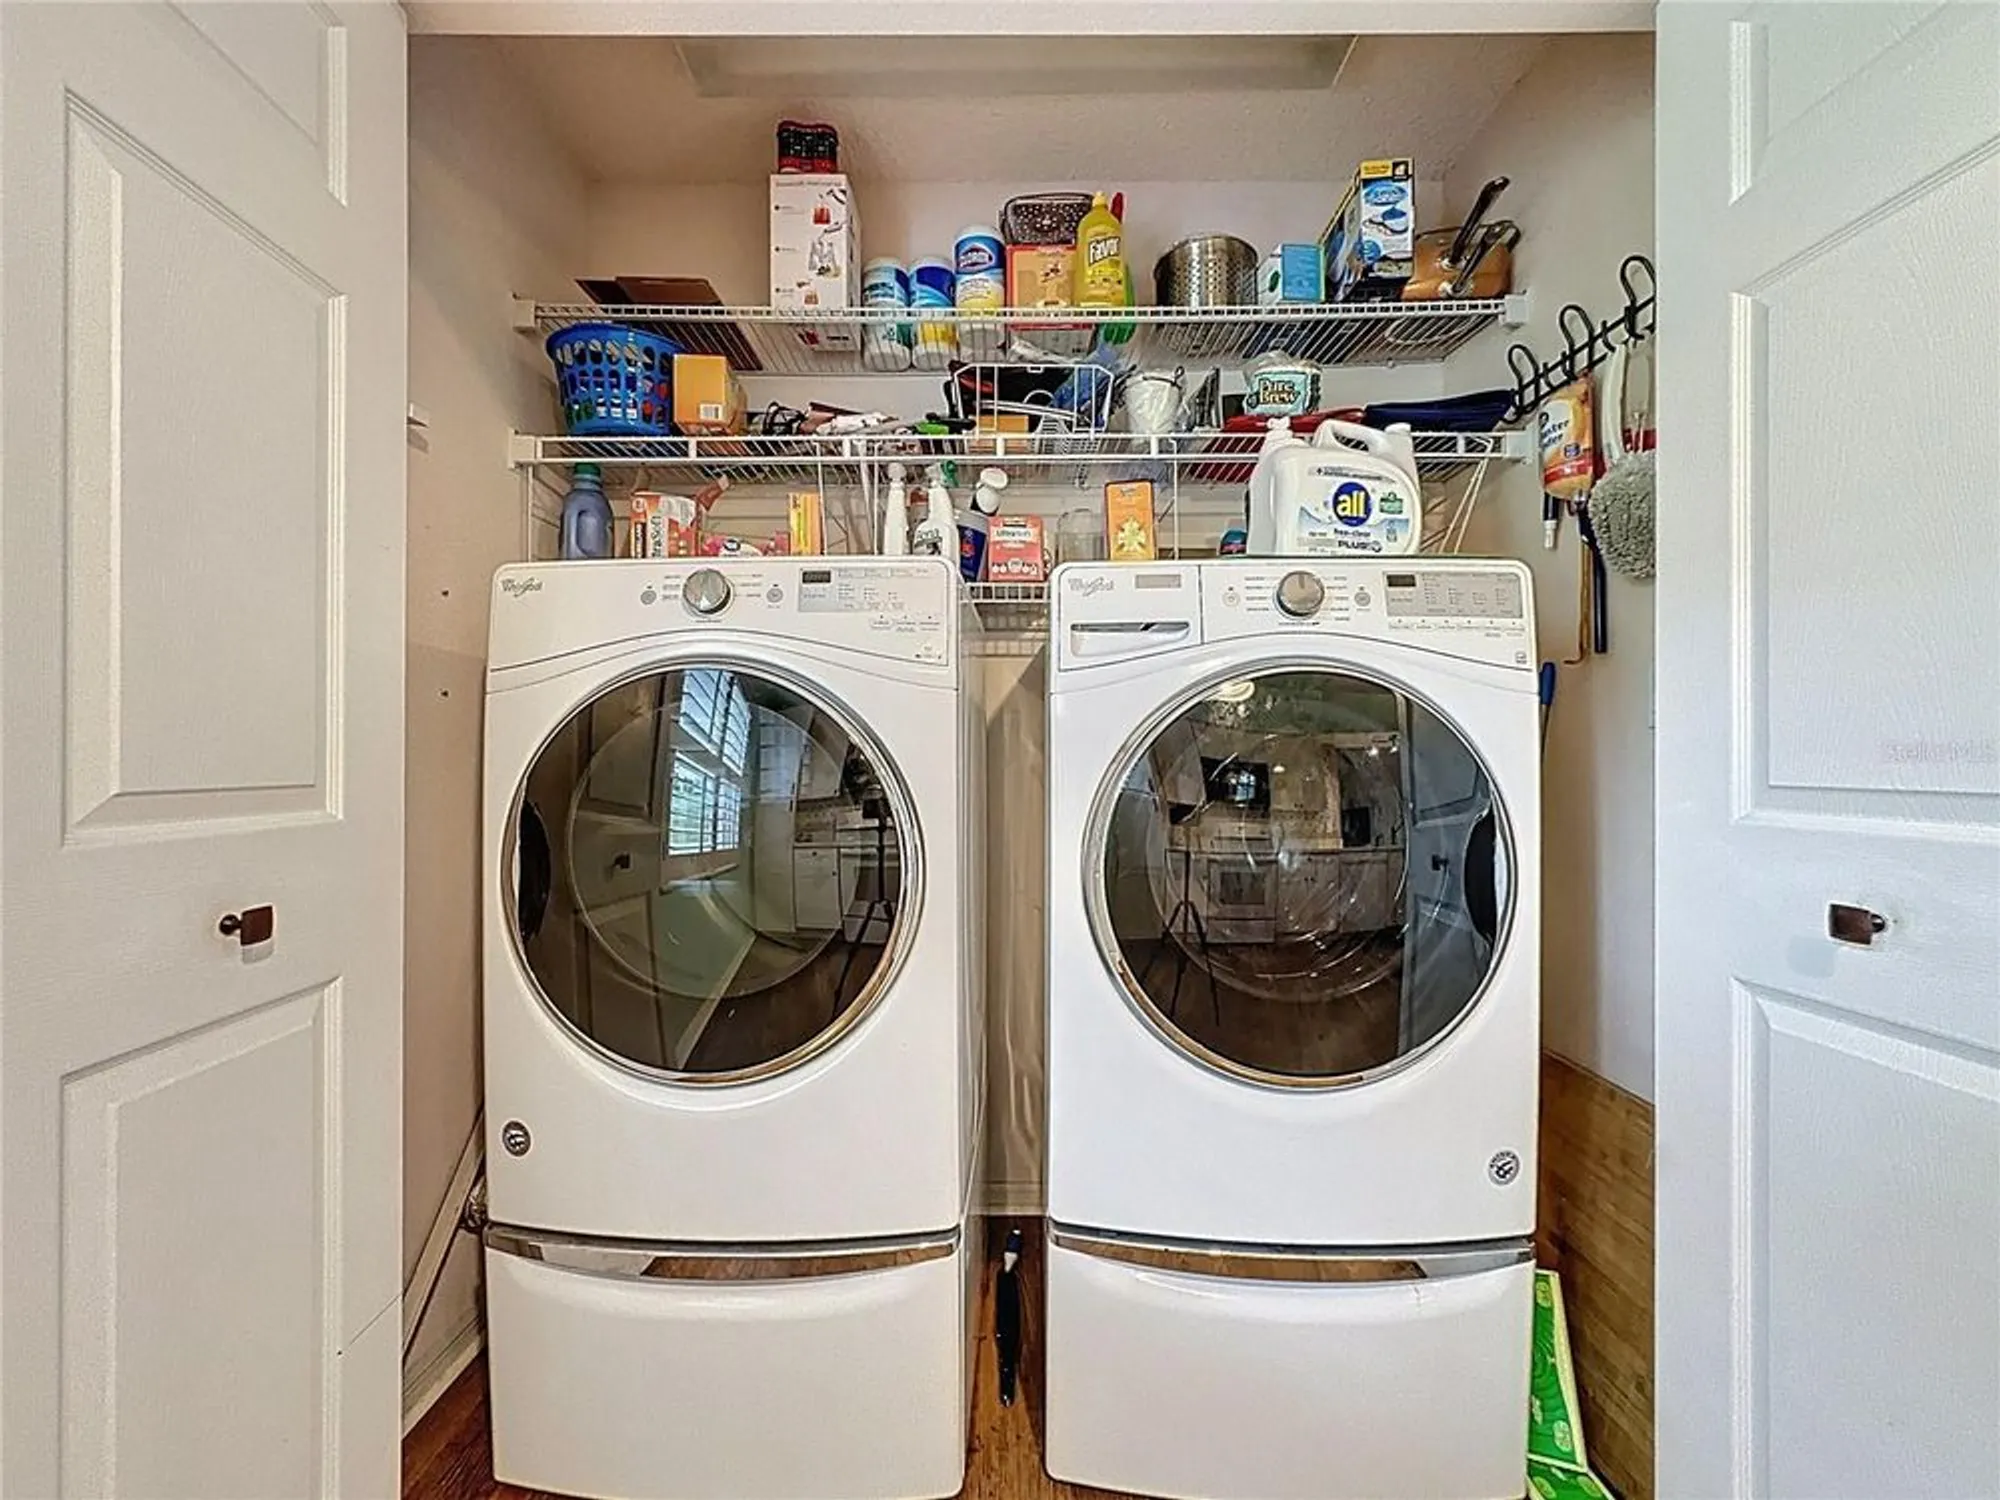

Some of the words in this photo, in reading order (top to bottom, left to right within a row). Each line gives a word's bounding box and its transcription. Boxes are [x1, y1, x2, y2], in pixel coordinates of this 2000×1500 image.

[1259, 379, 1294, 391] Pure
[1259, 390, 1296, 404] Brew
[1336, 490, 1366, 518] all
